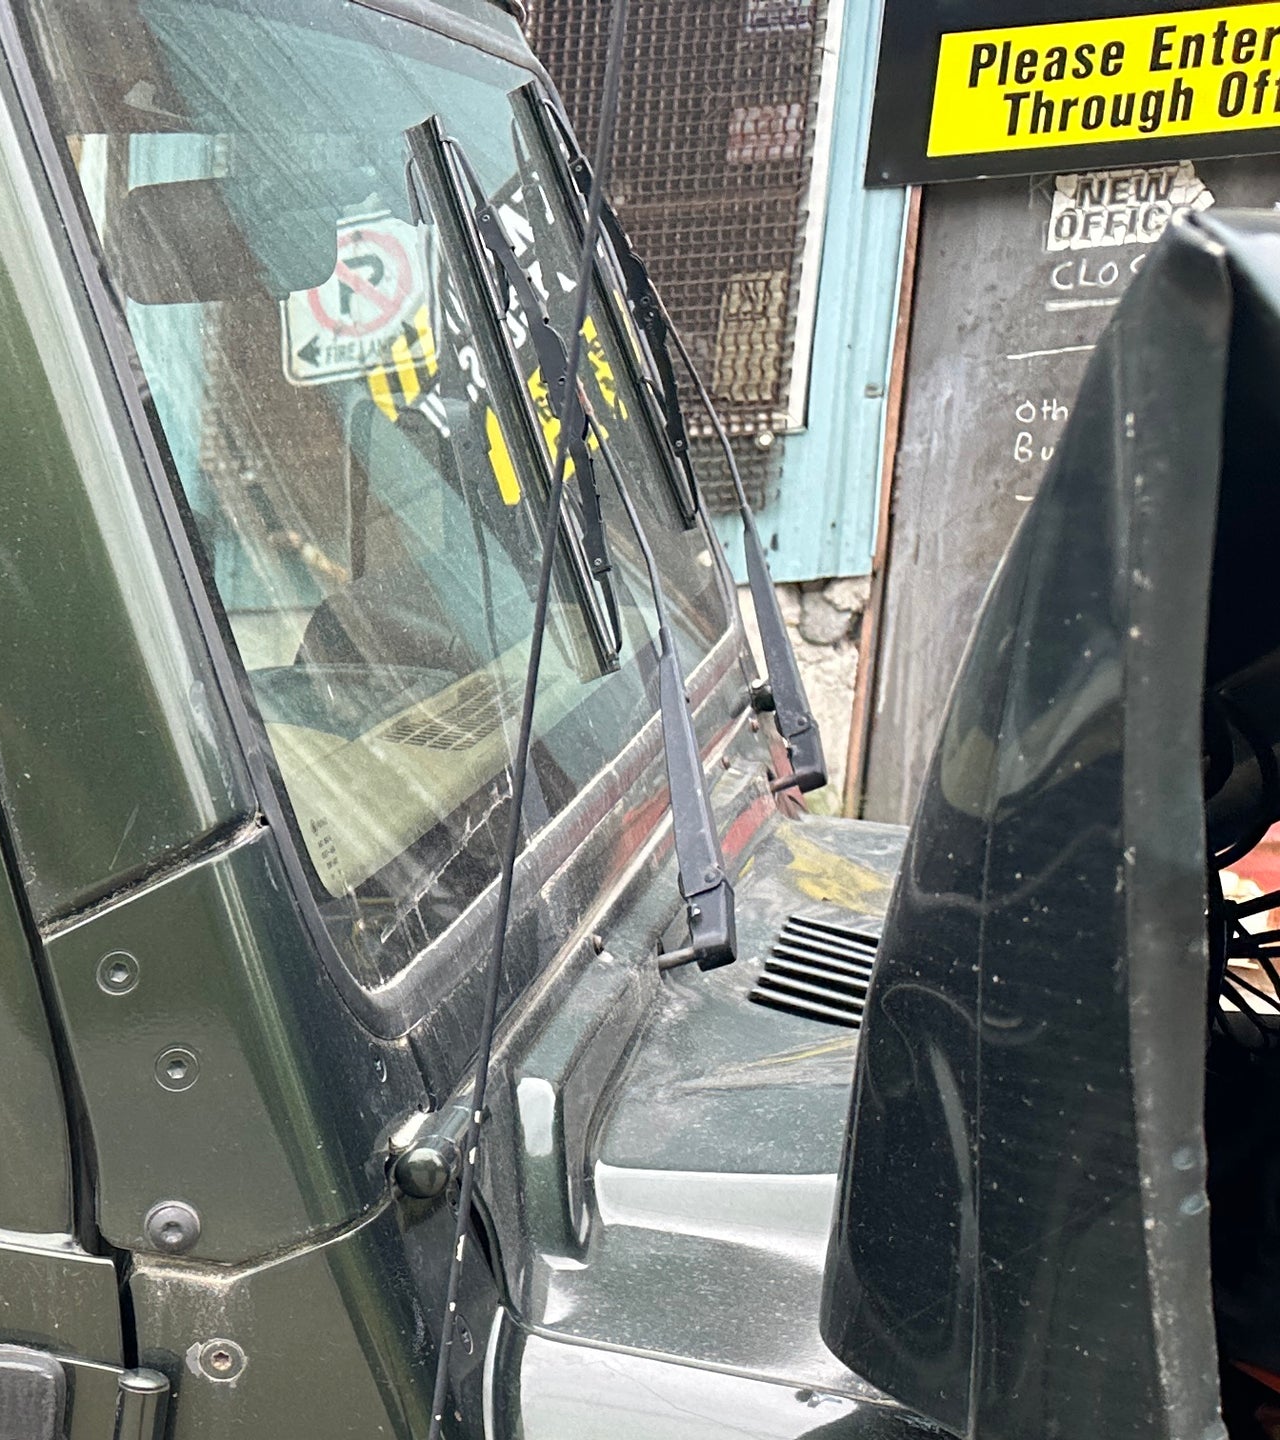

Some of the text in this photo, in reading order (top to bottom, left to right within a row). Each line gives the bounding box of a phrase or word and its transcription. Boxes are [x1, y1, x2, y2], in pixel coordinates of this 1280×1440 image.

[968, 20, 1280, 89] Please Enter
[1004, 76, 1195, 137] Through
[1076, 170, 1178, 209] NEW
[1054, 203, 1170, 242] OFFIC
[1015, 398, 1069, 423] Oth
